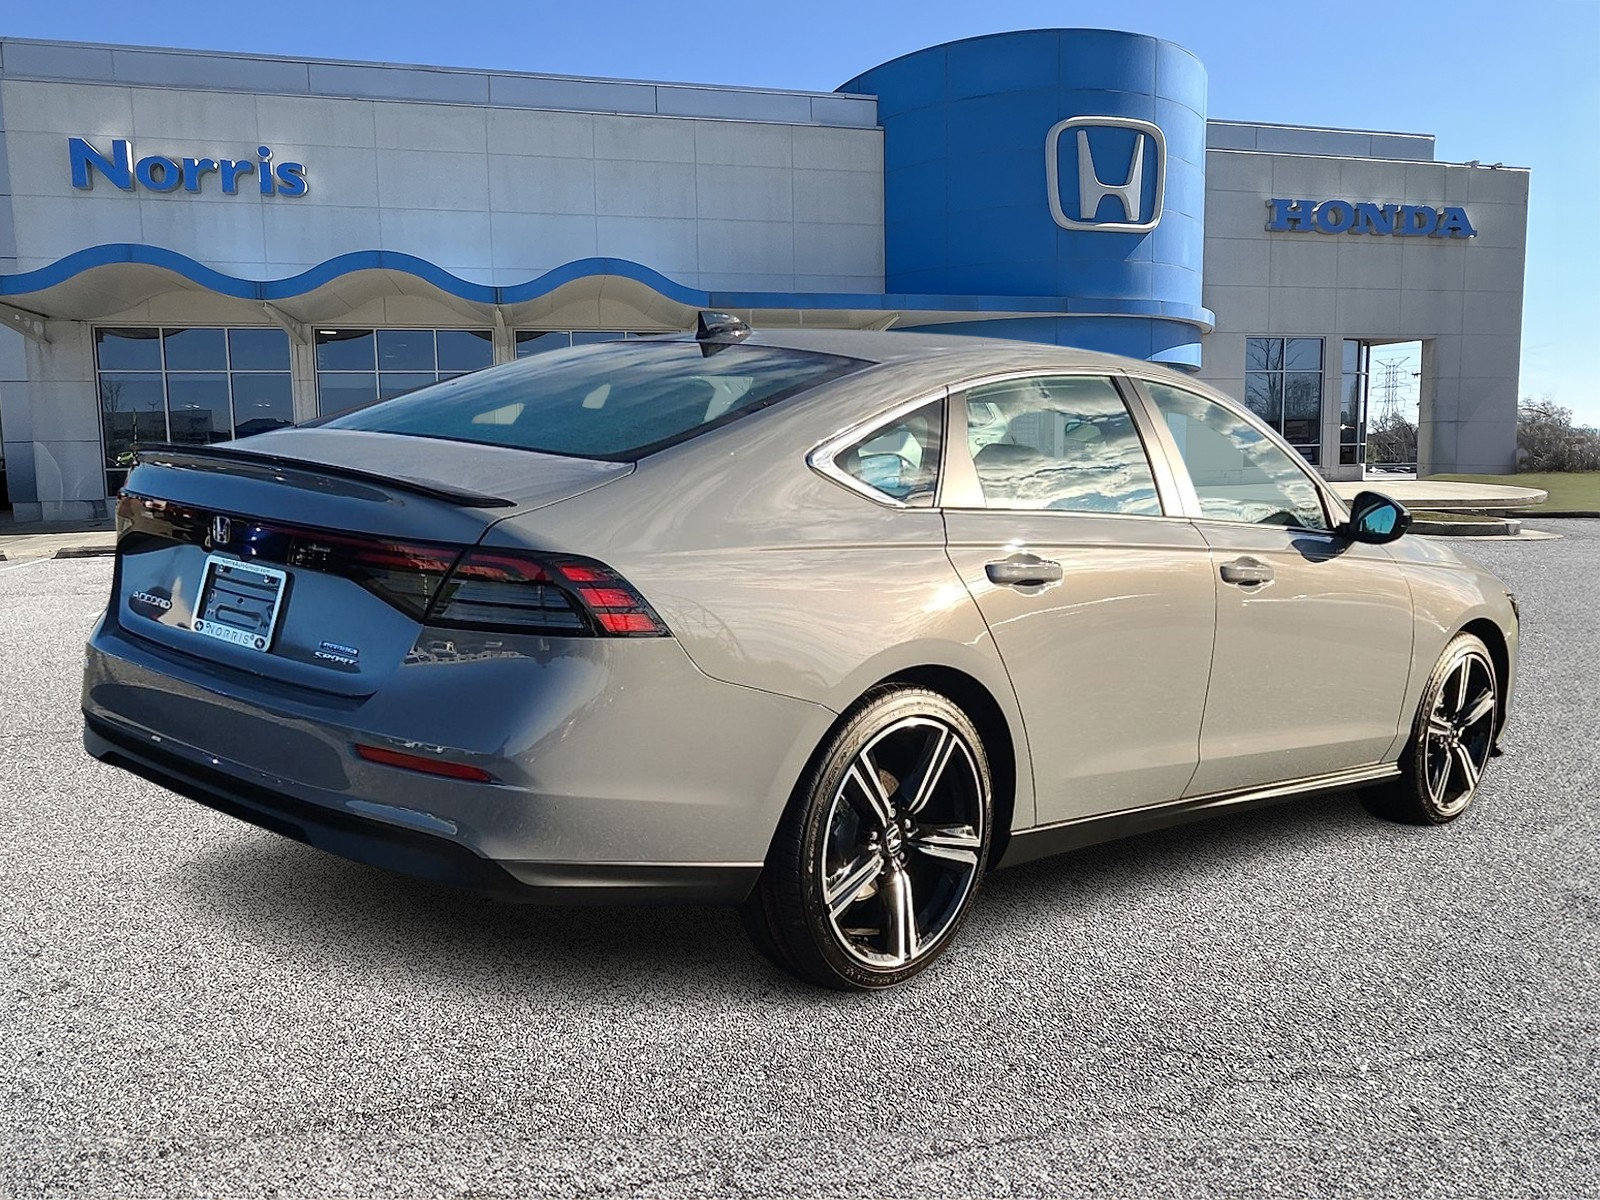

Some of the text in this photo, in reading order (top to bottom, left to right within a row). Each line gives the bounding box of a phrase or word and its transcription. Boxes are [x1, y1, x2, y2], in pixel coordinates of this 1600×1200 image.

[68, 137, 309, 197] Norris
[1265, 198, 1478, 239] HONDA
[132, 591, 171, 609] ACCORD
